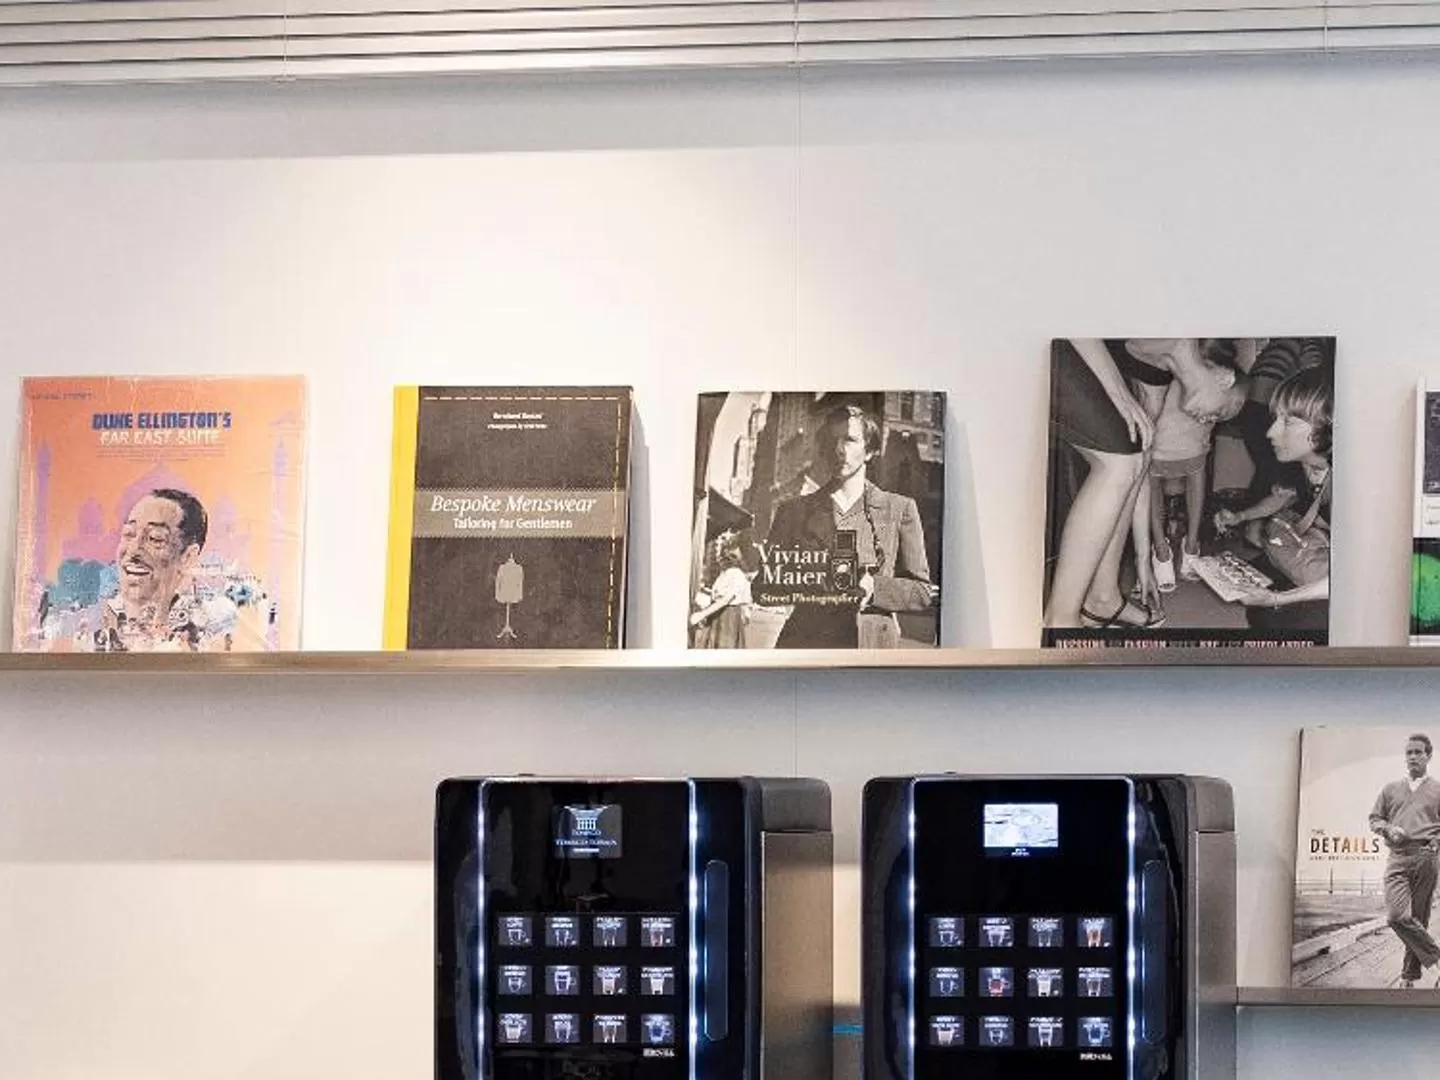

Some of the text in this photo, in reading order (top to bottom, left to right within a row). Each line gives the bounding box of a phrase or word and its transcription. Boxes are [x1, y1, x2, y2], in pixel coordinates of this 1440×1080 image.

[92, 412, 231, 429] DUKE ELLINGTON'S
[100, 429, 220, 445] FAR EAST SUITE
[431, 495, 597, 516] Bespoke Menswear
[453, 517, 573, 530] Tailoring for Gentlemen
[754, 542, 828, 564] Vivian
[762, 563, 827, 585] Maier
[1310, 837, 1380, 853] DETAILS
